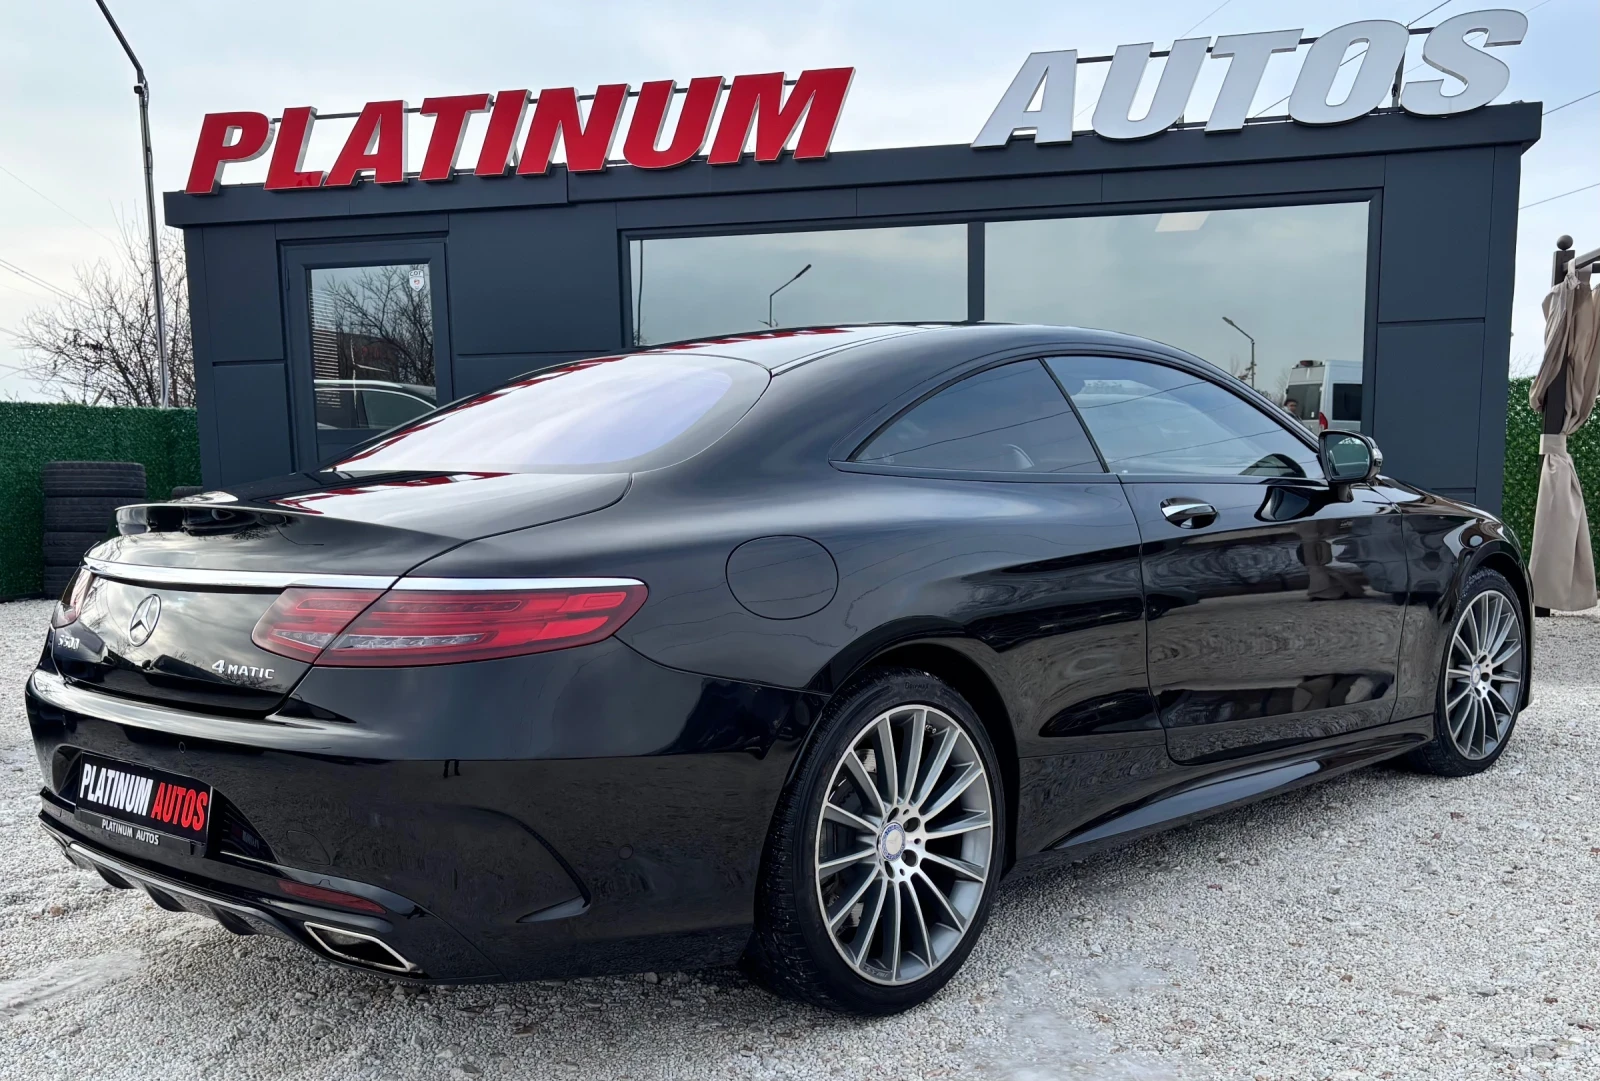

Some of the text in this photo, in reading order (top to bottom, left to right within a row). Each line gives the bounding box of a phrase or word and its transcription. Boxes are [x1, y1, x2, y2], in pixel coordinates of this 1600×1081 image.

[185, 9, 1528, 194] PLATINUM AUTOS
[79, 763, 208, 831] PLATINUM AUTOS
[102, 819, 160, 845] PLATINUM AUTOS
